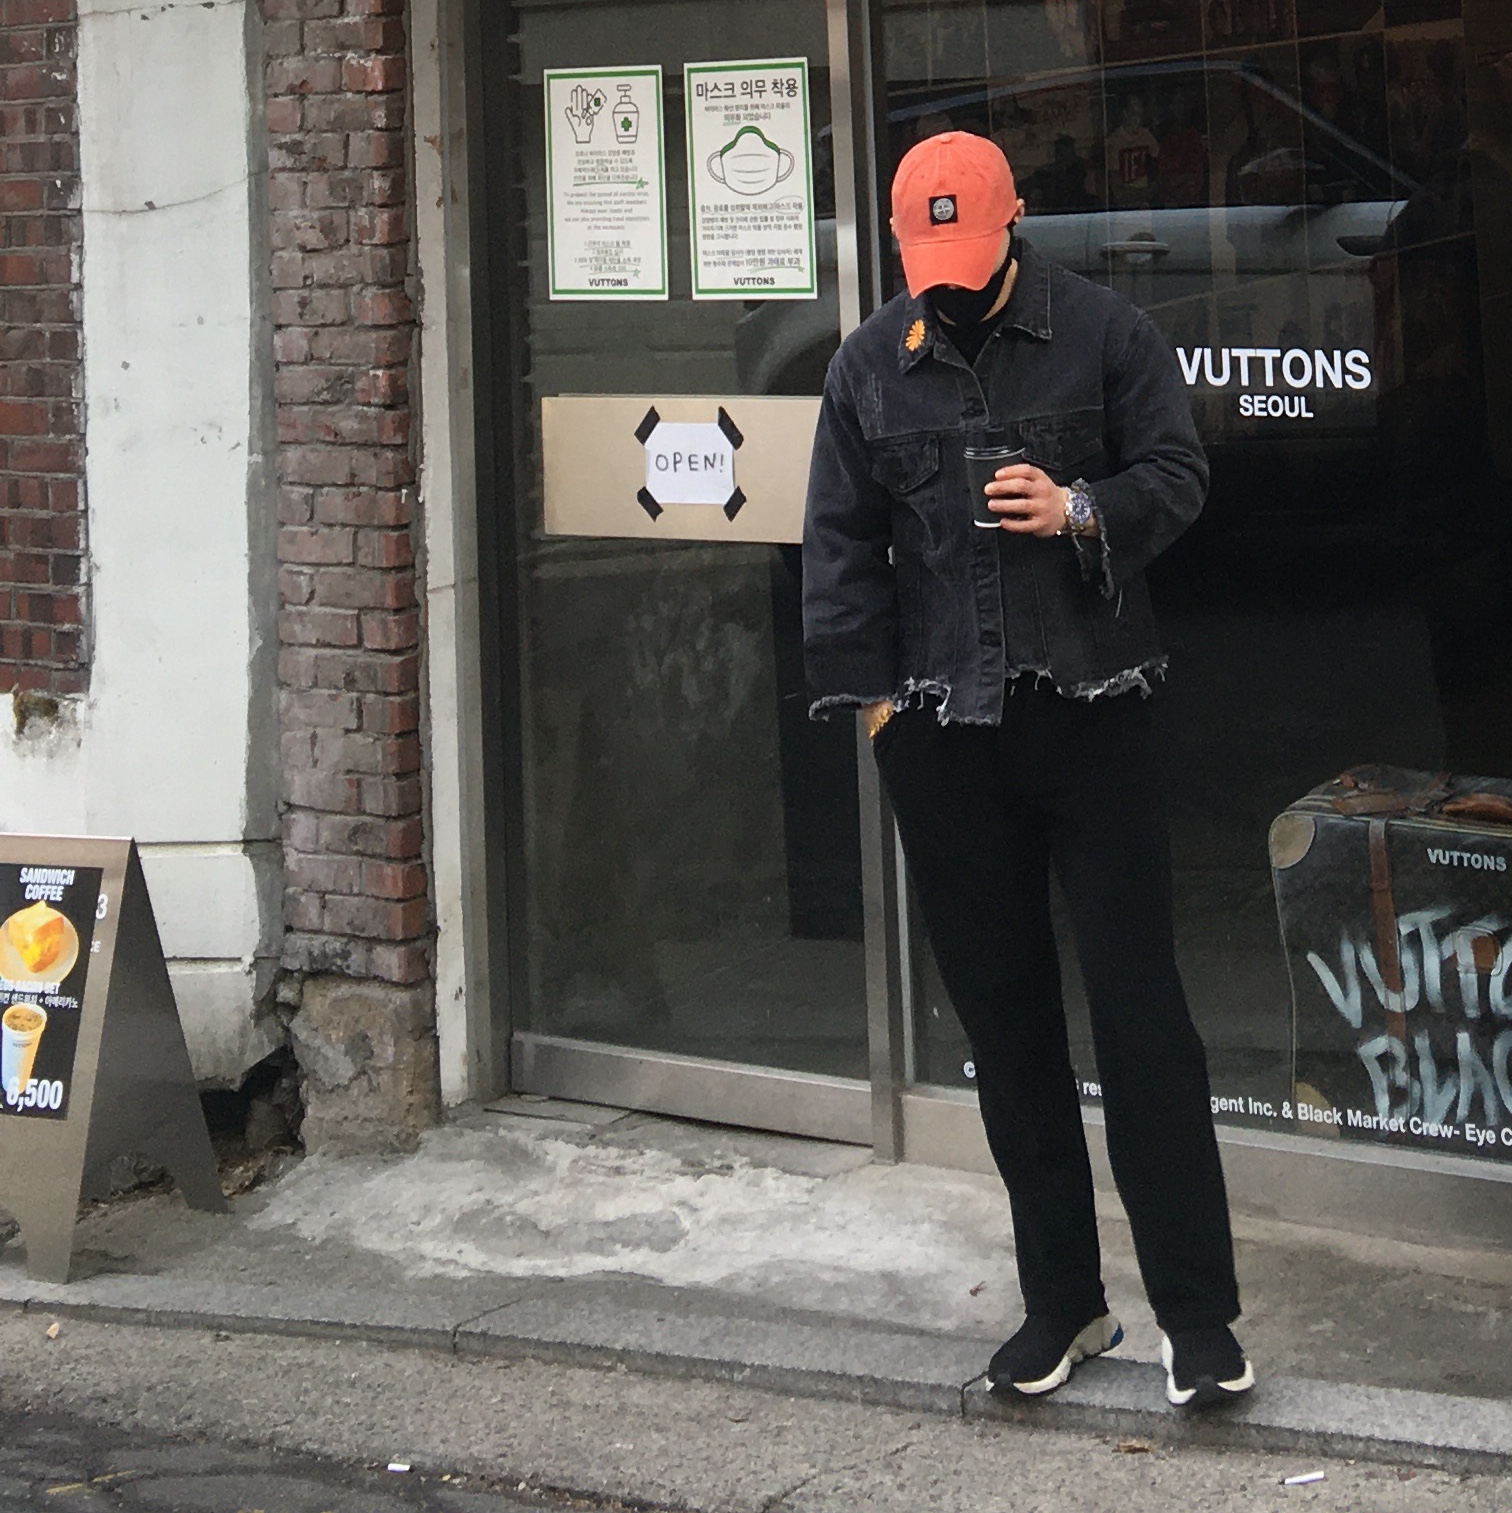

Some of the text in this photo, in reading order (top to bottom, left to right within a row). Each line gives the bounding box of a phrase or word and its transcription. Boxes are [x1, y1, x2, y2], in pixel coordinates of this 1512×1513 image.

[696, 78, 798, 101] 마스크 의무 착용
[588, 278, 628, 287] VUTTONS
[733, 277, 775, 286] VUTTONS
[1176, 347, 1372, 389] VUTTONS
[1239, 395, 1314, 418] SEOUL
[655, 451, 724, 473] OPEN!
[1426, 847, 1507, 872] VUTTONS
[20, 867, 75, 886] SANDWICH
[24, 884, 64, 901] COFFEE
[6, 1076, 63, 1112] 6,500
[1210, 1096, 1245, 1114] gent
[1249, 1098, 1277, 1118] Inc.
[1282, 1100, 1293, 1118] &
[1298, 1102, 1343, 1126] Black
[1347, 1110, 1406, 1133] Market
[1465, 1123, 1496, 1146] Eye
